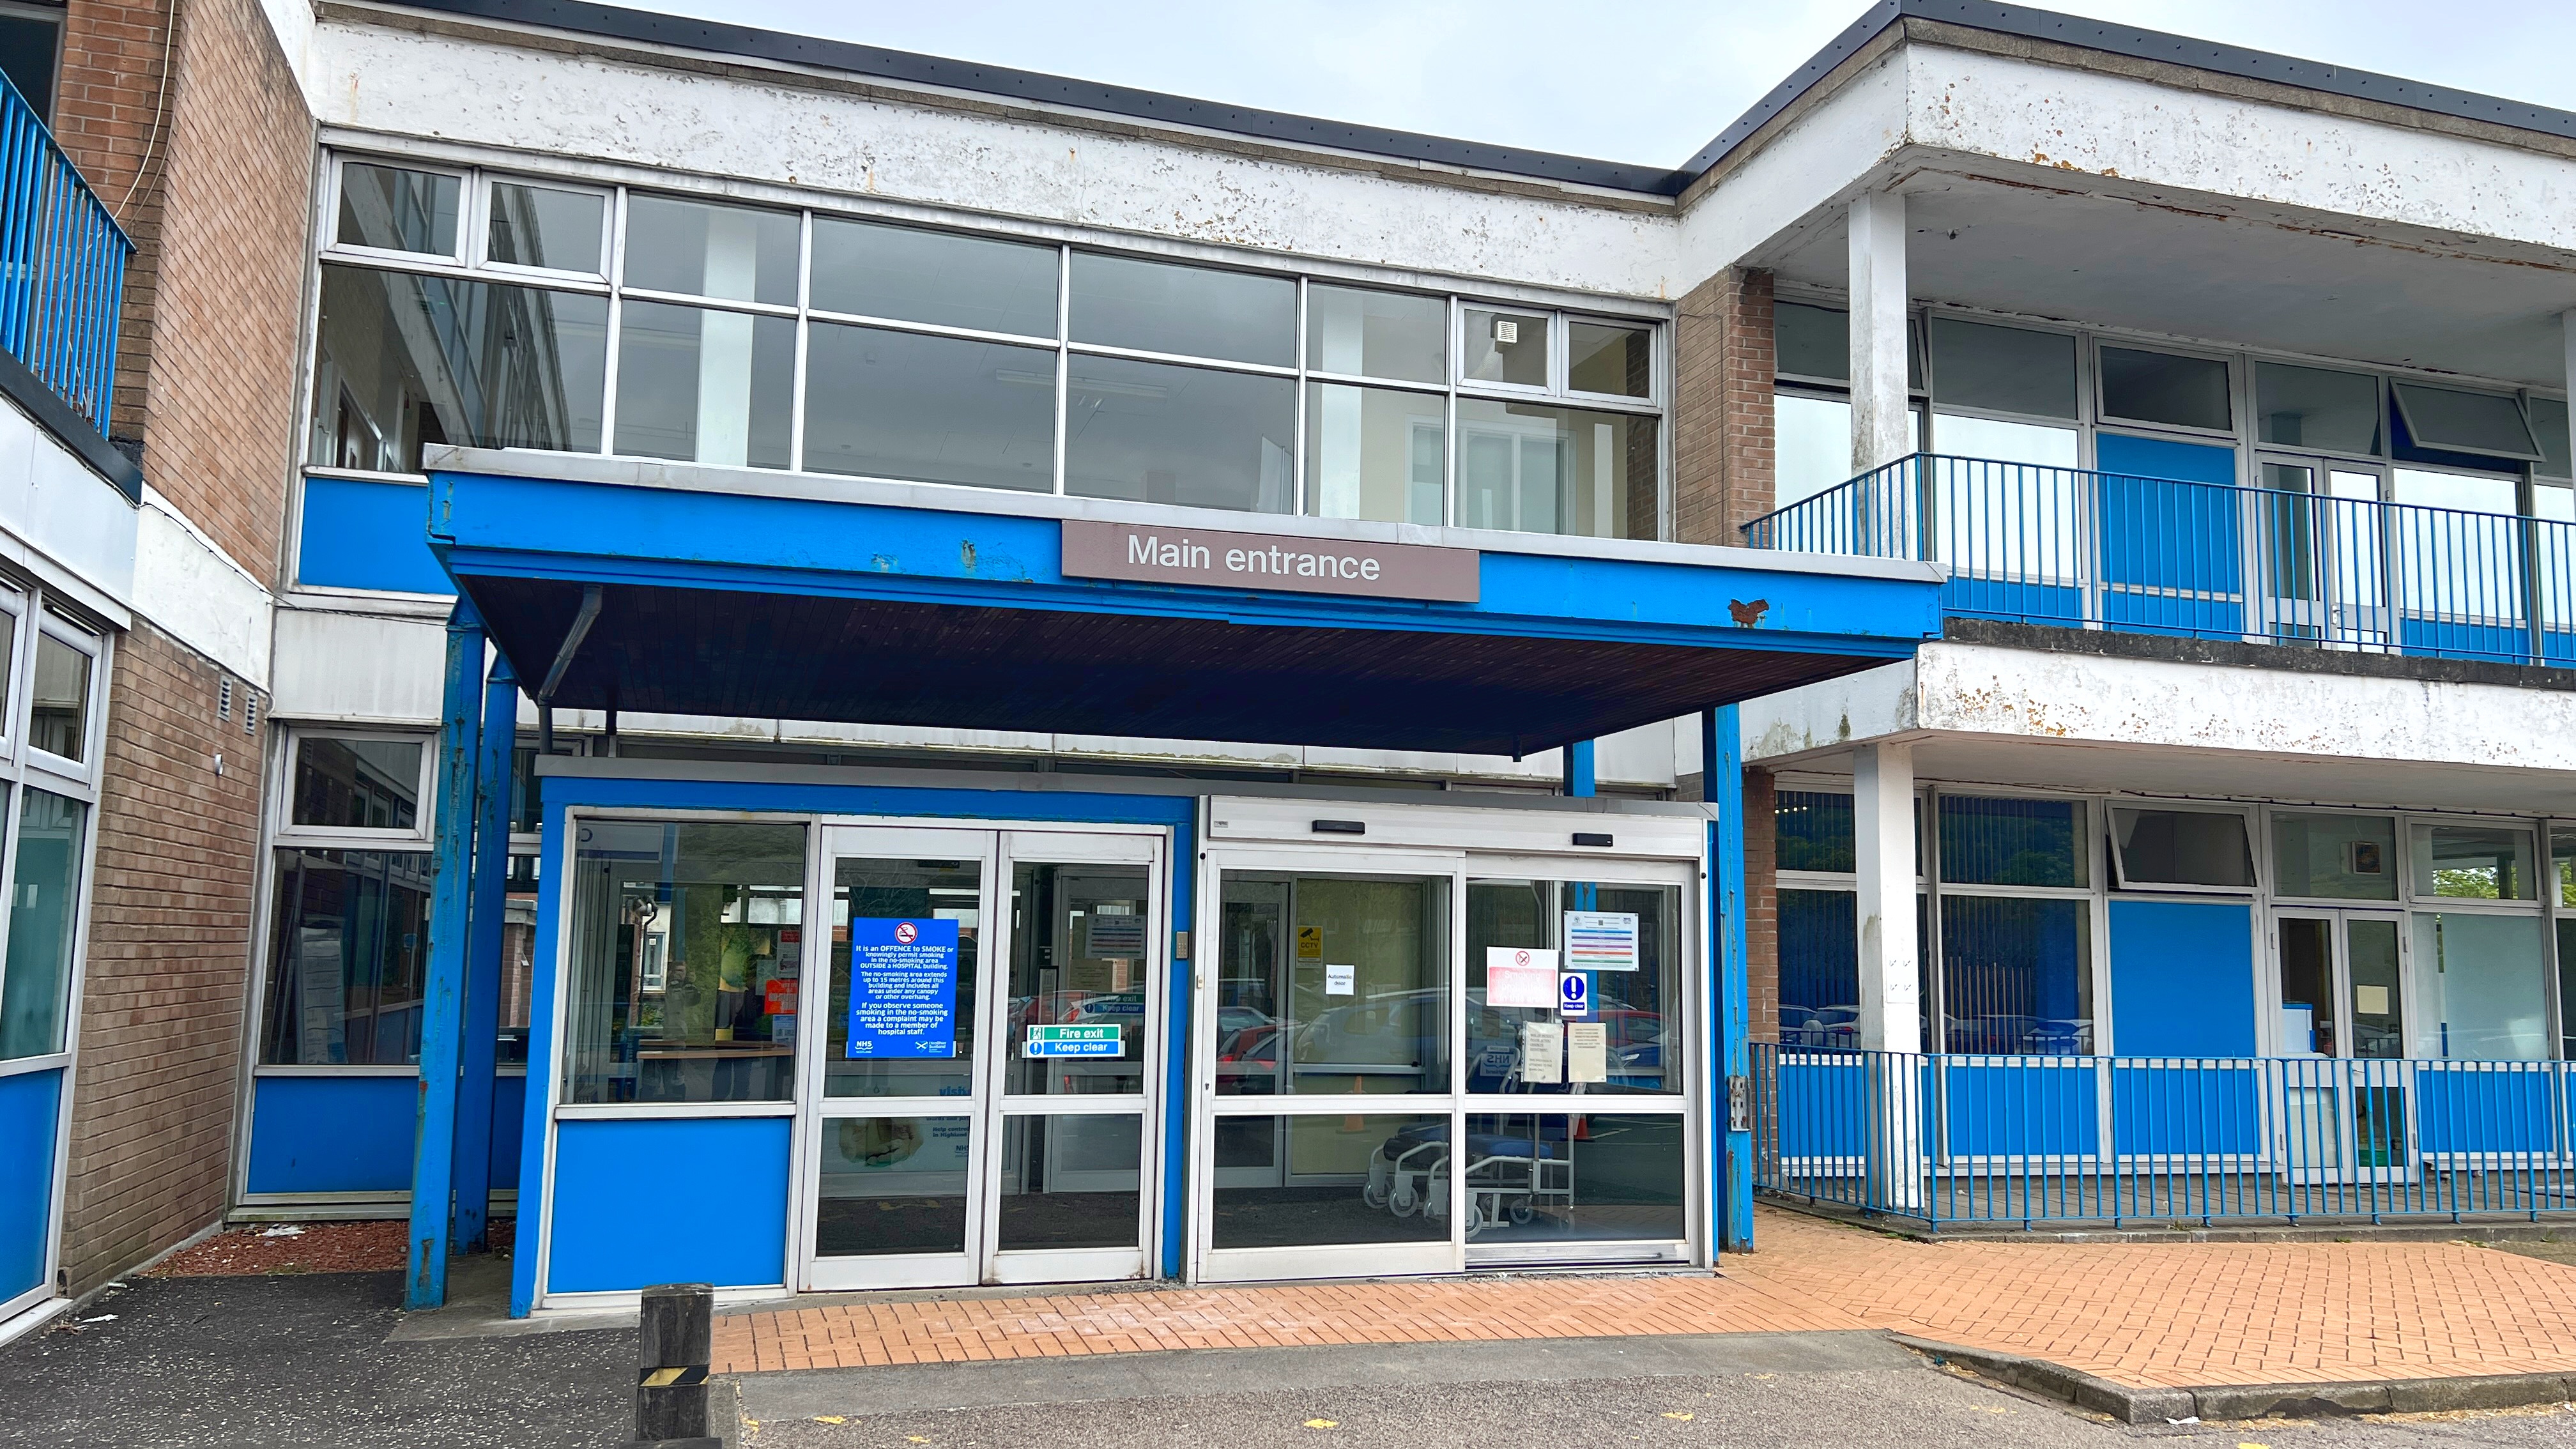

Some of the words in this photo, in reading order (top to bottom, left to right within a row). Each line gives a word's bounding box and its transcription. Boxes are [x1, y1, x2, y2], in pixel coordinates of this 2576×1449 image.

[1127, 534, 1211, 569] Main
[1224, 544, 1381, 582] entrance
[1059, 1029, 1081, 1038] Fire
[1084, 1029, 1104, 1038] exit
[1055, 1043, 1080, 1053] Keep
[1083, 1043, 1108, 1051] clear
